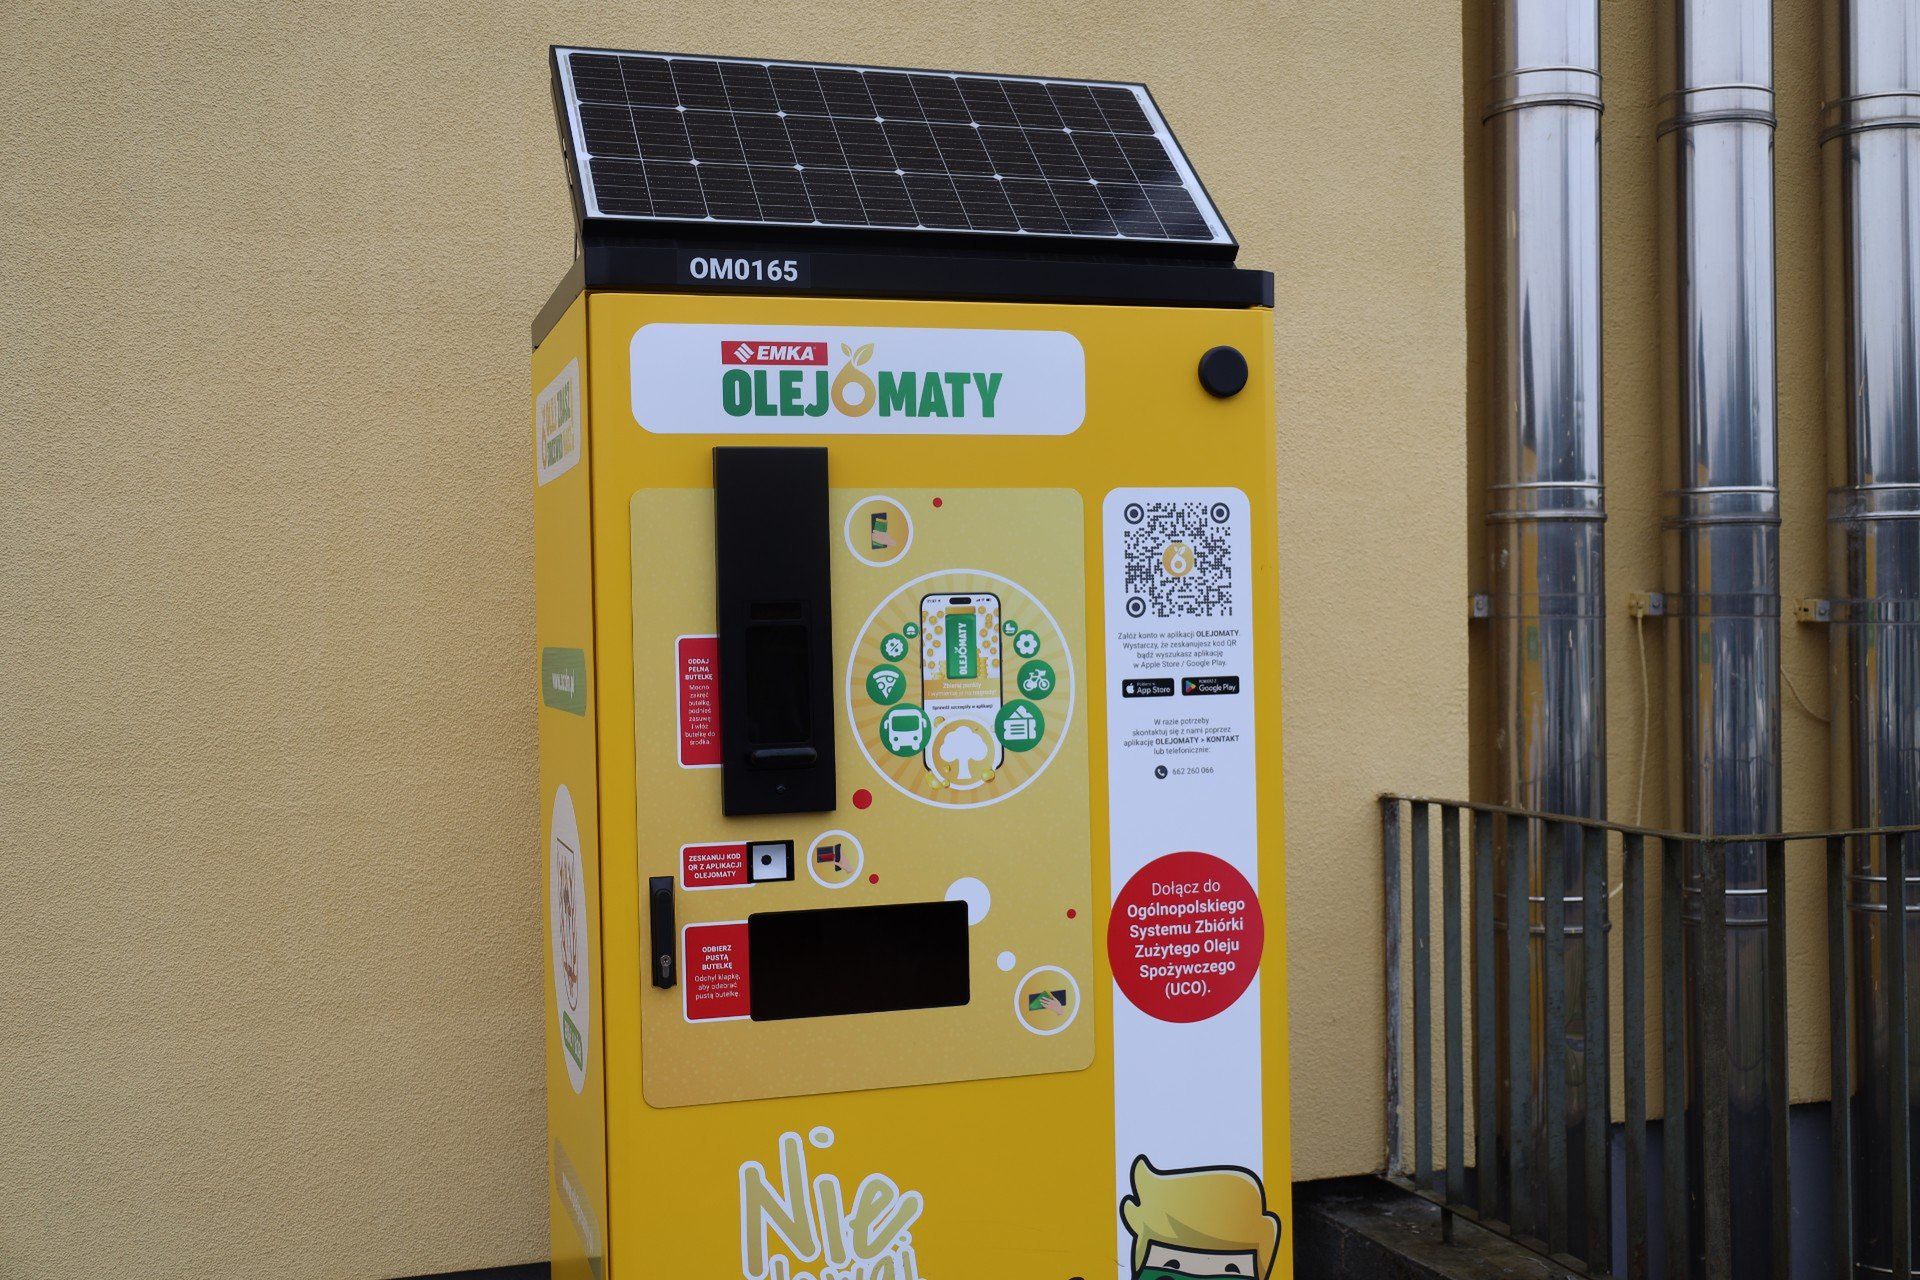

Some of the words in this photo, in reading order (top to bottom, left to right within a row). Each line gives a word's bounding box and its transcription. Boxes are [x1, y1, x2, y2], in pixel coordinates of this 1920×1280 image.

[689, 257, 799, 282] OM0165
[757, 345, 815, 361] EMKA
[722, 366, 1003, 418] OLEJOMATY
[1227, 639, 1237, 647] QR
[957, 622, 968, 675] OLEJOMATY
[1141, 661, 1161, 669] Apple
[1187, 659, 1210, 668] Google
[1137, 686, 1151, 695] App
[1153, 685, 1171, 693] Store
[1199, 684, 1222, 693] Google
[1223, 683, 1236, 691] Play
[1180, 717, 1209, 726] potrzeby
[1205, 727, 1231, 735] poprzez
[1155, 737, 1199, 745] OLEJOMATY
[1206, 735, 1239, 743] KONTAKT
[1187, 767, 1200, 775] 260
[1201, 766, 1214, 774] 066
[688, 854, 725, 862] ZESKANUJ
[706, 862, 742, 870] APLIKACJI
[694, 870, 736, 879] OLEJOMATY
[1152, 881, 1199, 897] Dołącz
[1203, 879, 1221, 892] do
[1127, 899, 1245, 920] Ogólnopolskiego
[1129, 923, 1192, 940] Systemu
[1195, 917, 1244, 934] Zbiórki
[702, 945, 732, 953] ODBIERZ
[1135, 943, 1200, 960] Zużytego
[1204, 938, 1240, 955] Oleju
[1139, 960, 1236, 980] Spożywczego
[1165, 980, 1211, 999] (UCO).
[739, 1125, 924, 1279] Nie
